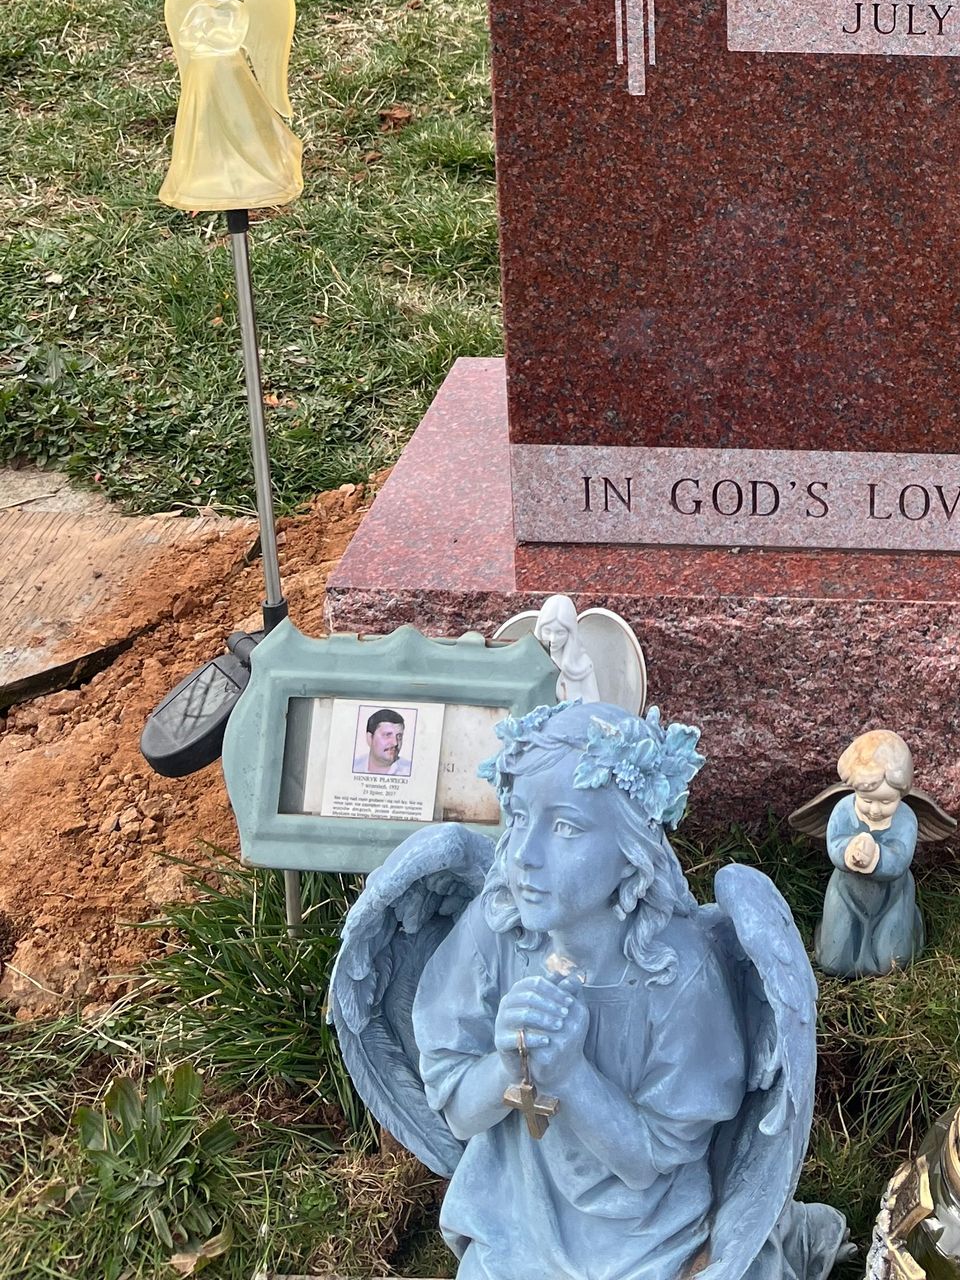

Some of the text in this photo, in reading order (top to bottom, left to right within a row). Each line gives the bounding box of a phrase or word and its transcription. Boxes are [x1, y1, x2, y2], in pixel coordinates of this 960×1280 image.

[841, 1, 955, 37] JULY
[581, 476, 633, 514] IN
[670, 477, 830, 518] GOD'S
